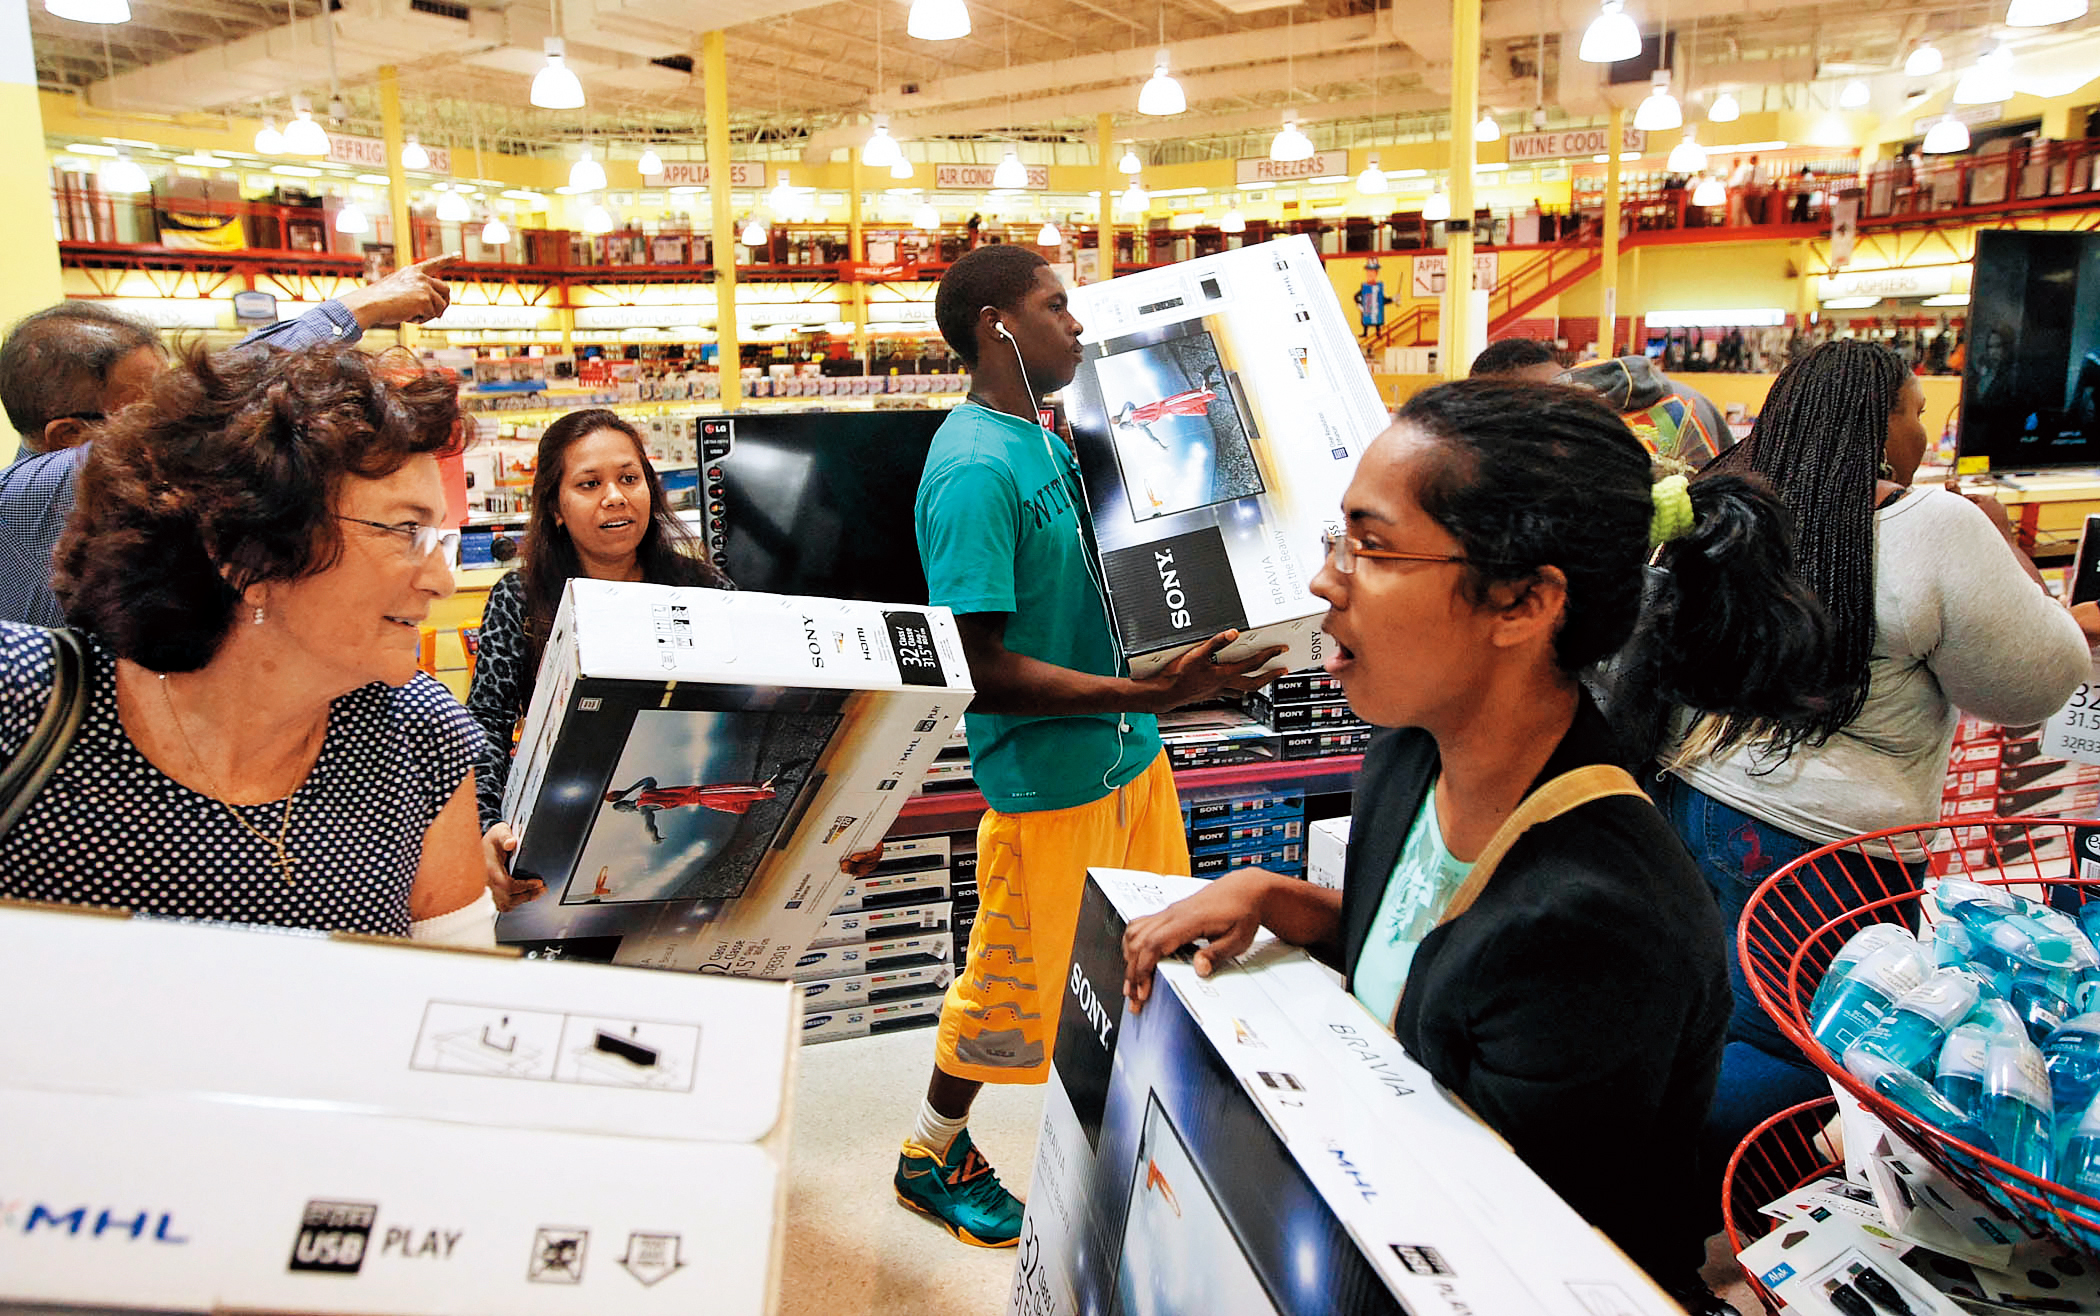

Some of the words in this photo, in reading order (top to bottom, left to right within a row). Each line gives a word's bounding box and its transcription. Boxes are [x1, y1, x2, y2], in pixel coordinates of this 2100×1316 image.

[331, 139, 449, 170] EFRIGRS
[1514, 136, 1556, 155] WINE
[1564, 130, 1641, 152] COOLRS
[663, 165, 747, 183] APPLIAES
[938, 168, 957, 185] AIR
[961, 168, 1047, 186] CONDERS
[1257, 156, 1325, 178] FREEZERS
[1417, 257, 1492, 271] APPLES
[1274, 528, 1291, 562] Beauty
[1154, 550, 1192, 630] SONY
[1261, 555, 1286, 606] BRAVIA
[802, 614, 825, 669] SONY
[1311, 631, 1323, 661] SONY
[899, 648, 923, 668] 32
[927, 704, 941, 719] PLAY
[1279, 710, 1304, 718] SONY
[900, 737, 921, 761] MHL
[1288, 738, 1313, 746] SONY
[1200, 804, 1225, 814] SONY
[1199, 832, 1225, 841] SONY
[1198, 859, 1224, 868] SONY
[699, 962, 732, 976] 2
[1071, 962, 1113, 1048] SONY
[1328, 1023, 1417, 1097] BRAVIA
[1044, 1113, 1066, 1177] BRAVIA
[1328, 1149, 1378, 1205] MHL
[25, 1203, 189, 1244] MHL
[296, 1229, 366, 1265] USB
[381, 1226, 463, 1258] PLAY
[1020, 1215, 1040, 1297] 32
